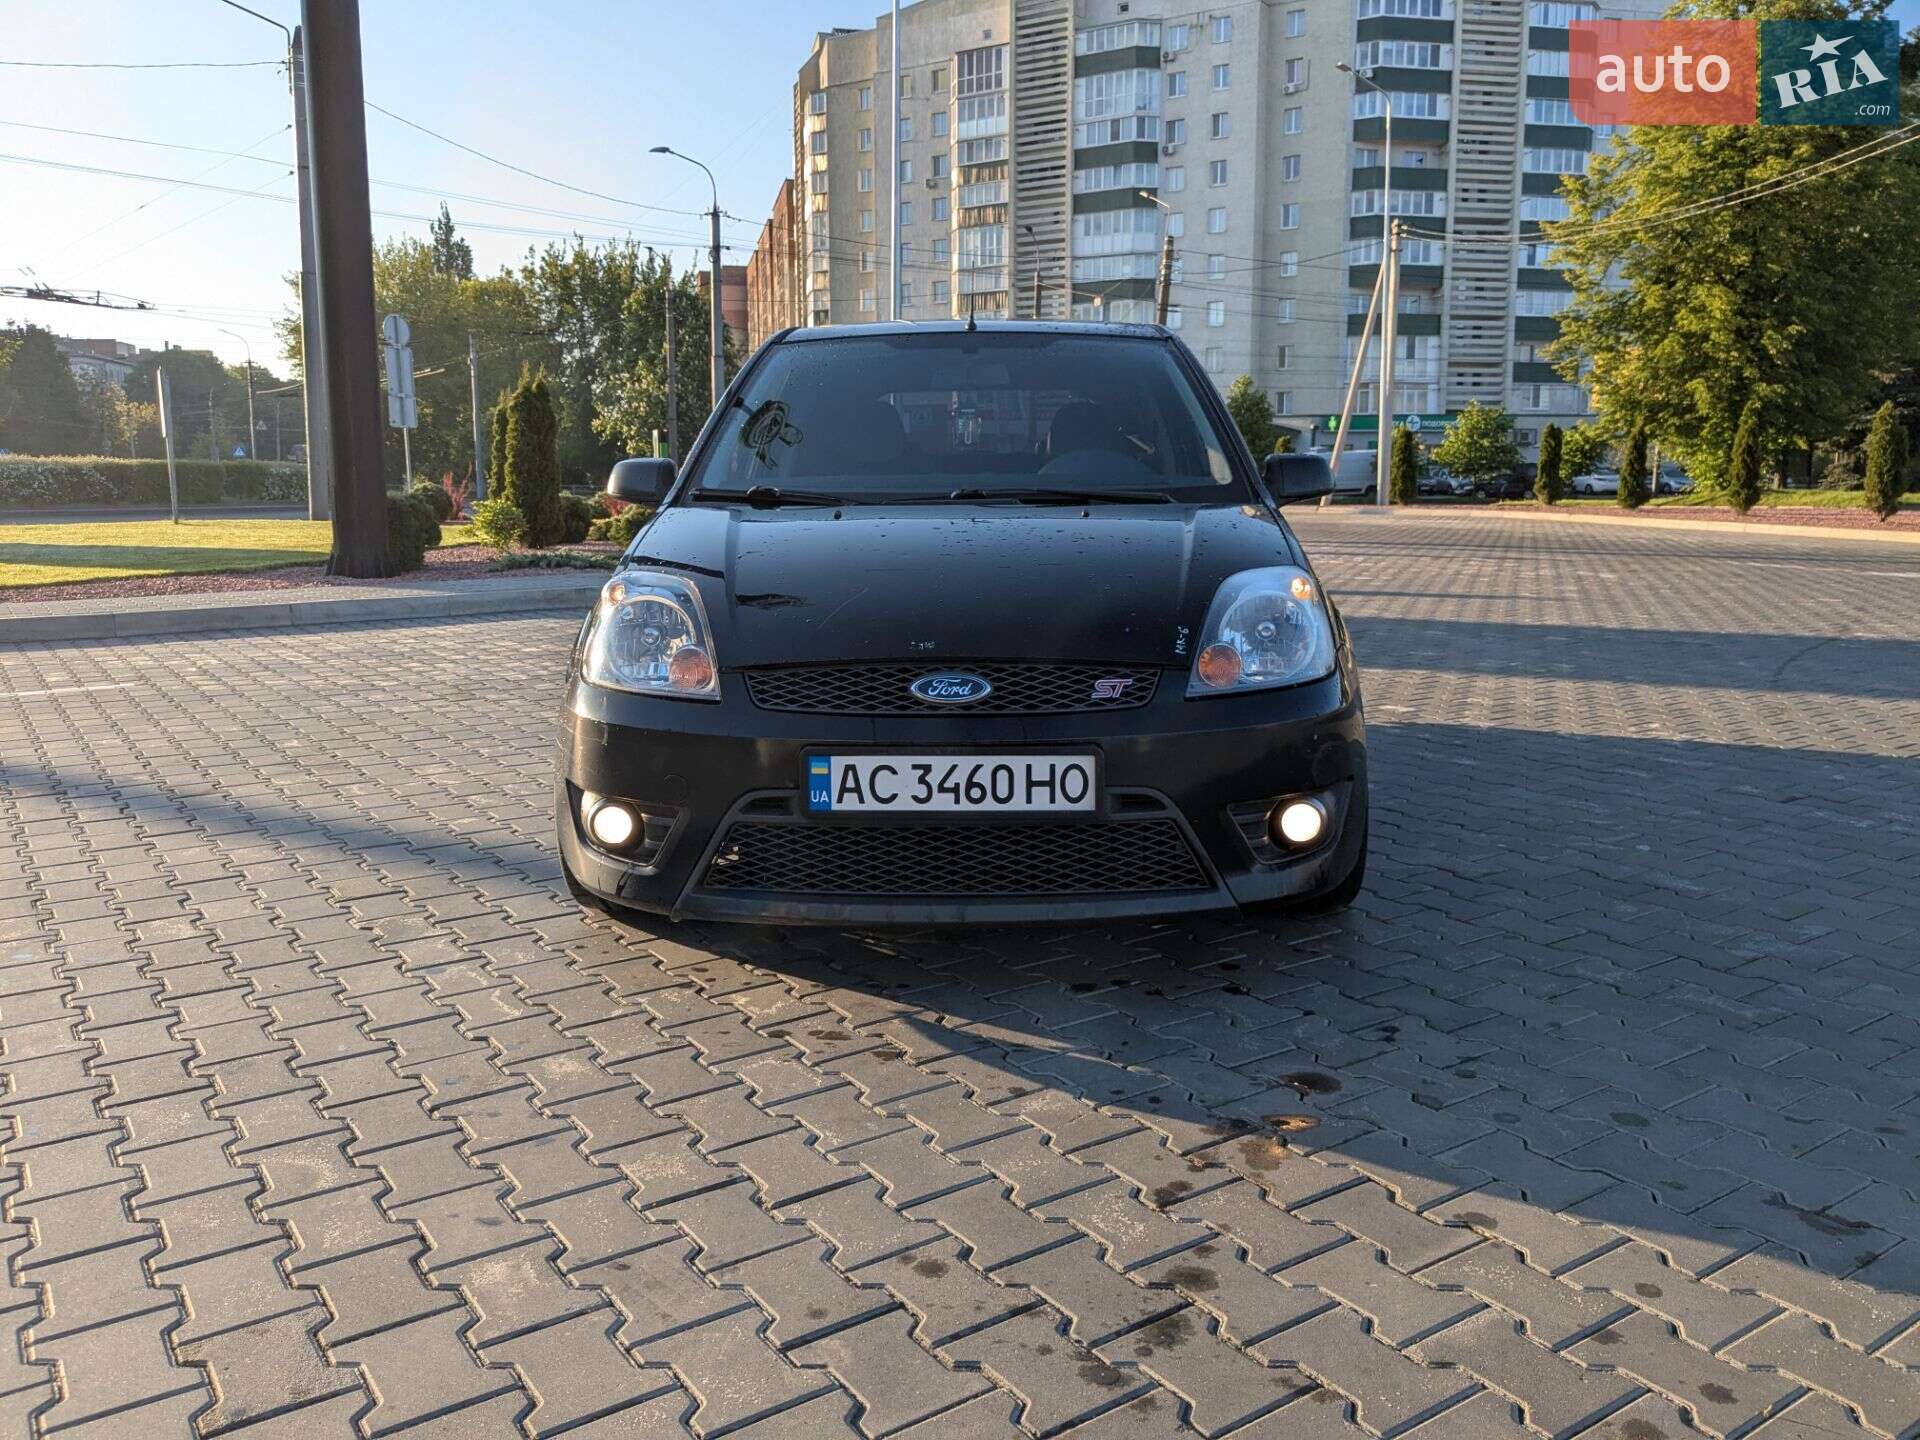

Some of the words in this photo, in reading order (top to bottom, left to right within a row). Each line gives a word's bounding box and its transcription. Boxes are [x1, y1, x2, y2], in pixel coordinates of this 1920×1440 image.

[928, 678, 973, 696] Ford
[1091, 678, 1133, 699] ST
[836, 763, 899, 805] AC
[910, 763, 1015, 805] 3460
[1025, 762, 1090, 805] HO
[811, 790, 830, 803] UA
